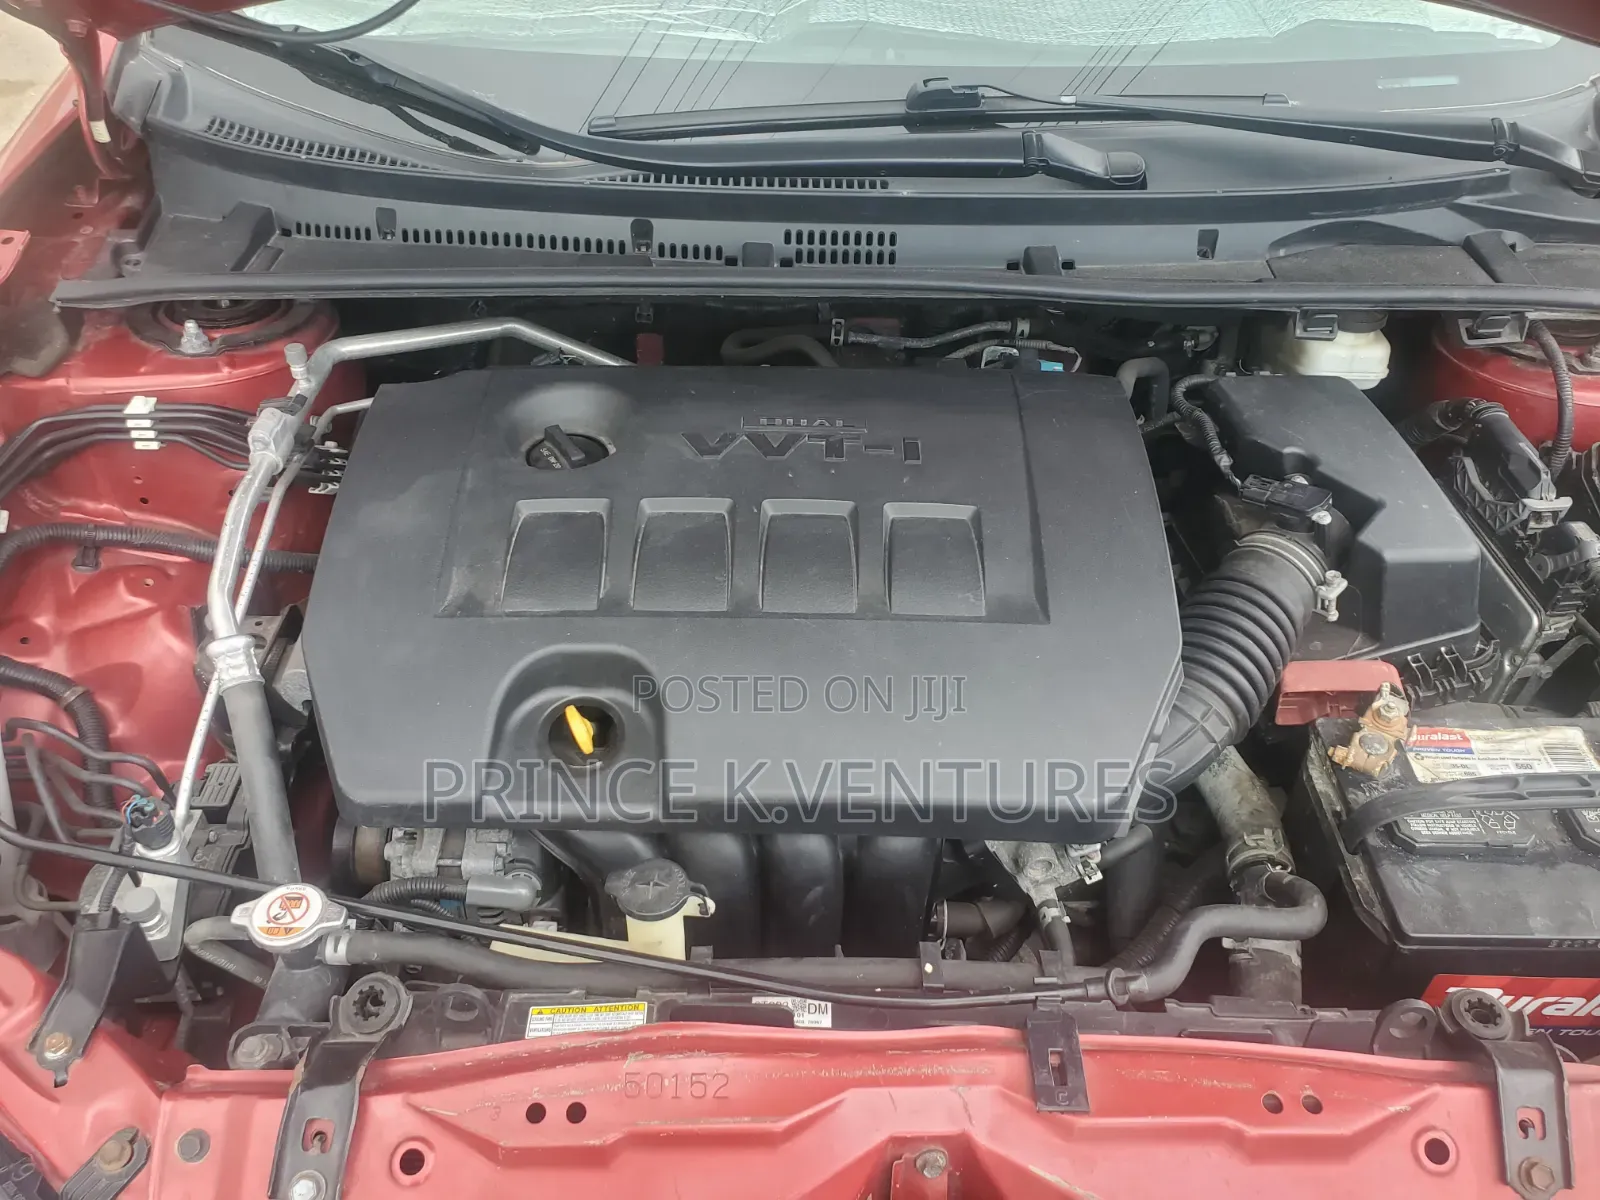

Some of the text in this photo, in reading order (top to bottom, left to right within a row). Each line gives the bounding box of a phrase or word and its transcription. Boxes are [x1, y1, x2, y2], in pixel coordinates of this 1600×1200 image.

[550, 1004, 639, 1015] CAUTION ATTENTION
[808, 1003, 828, 1015] DM
[1558, 1028, 1600, 1036] TOU
[624, 1072, 729, 1099] 50152
